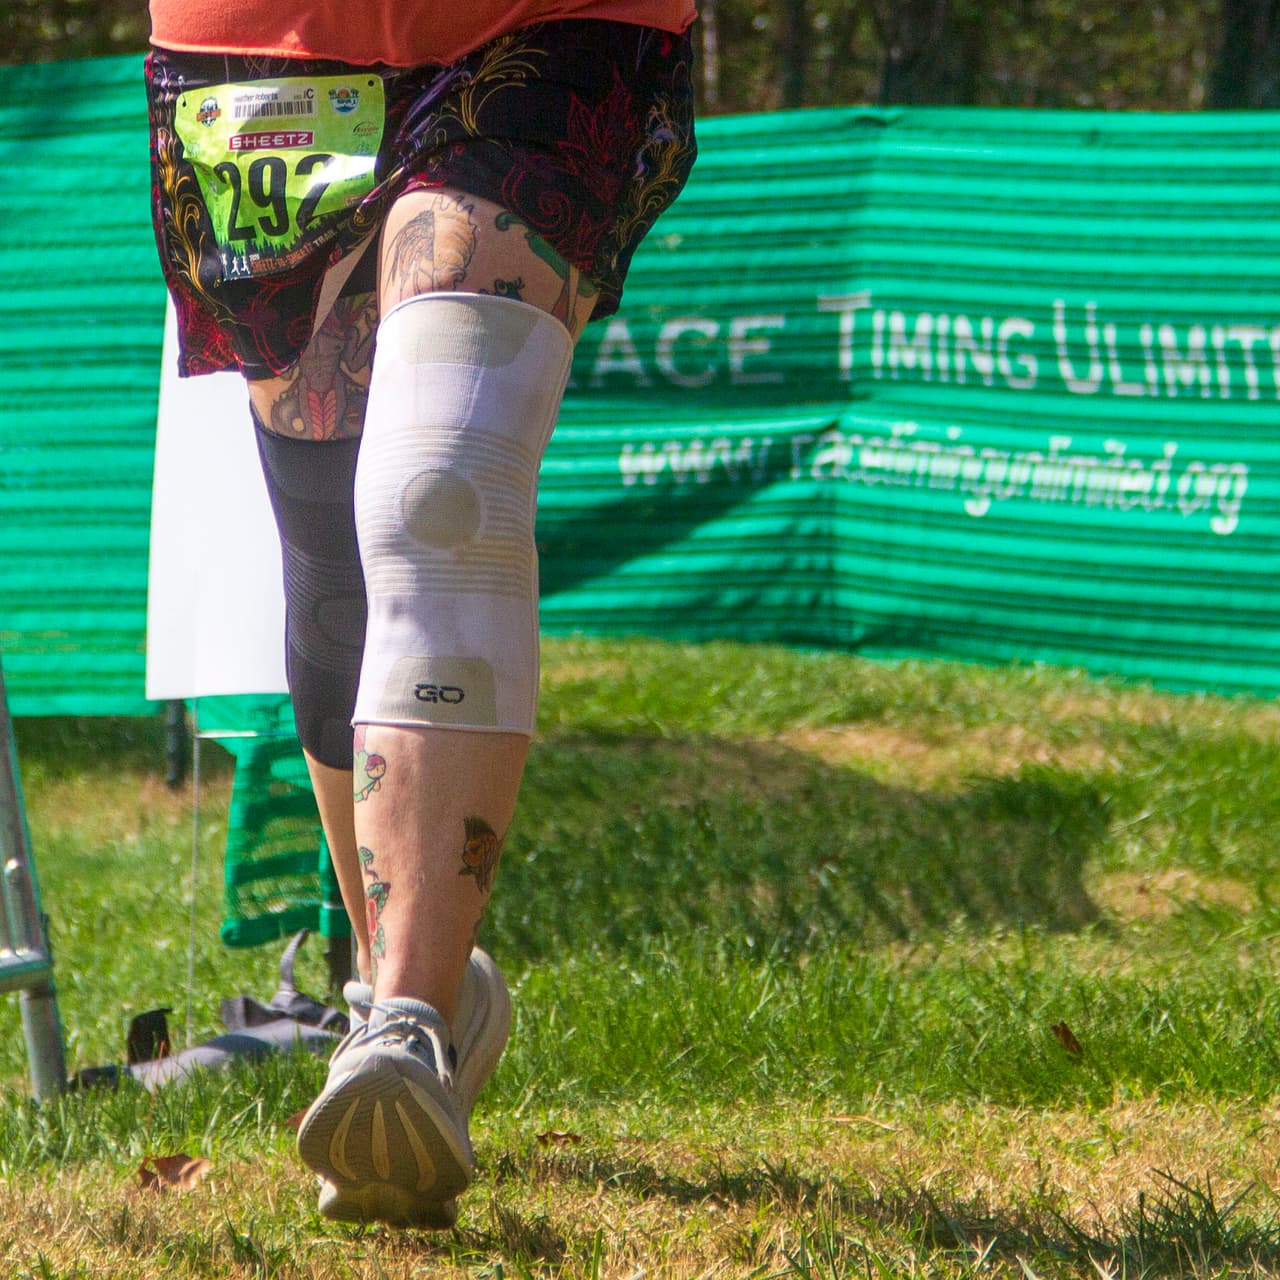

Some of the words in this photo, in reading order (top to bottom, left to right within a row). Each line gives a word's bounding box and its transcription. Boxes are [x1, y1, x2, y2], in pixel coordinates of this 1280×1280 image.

[231, 131, 310, 150] SHEETZ
[213, 153, 336, 242] 292
[564, 314, 786, 388] ACE
[415, 683, 465, 705] GO
